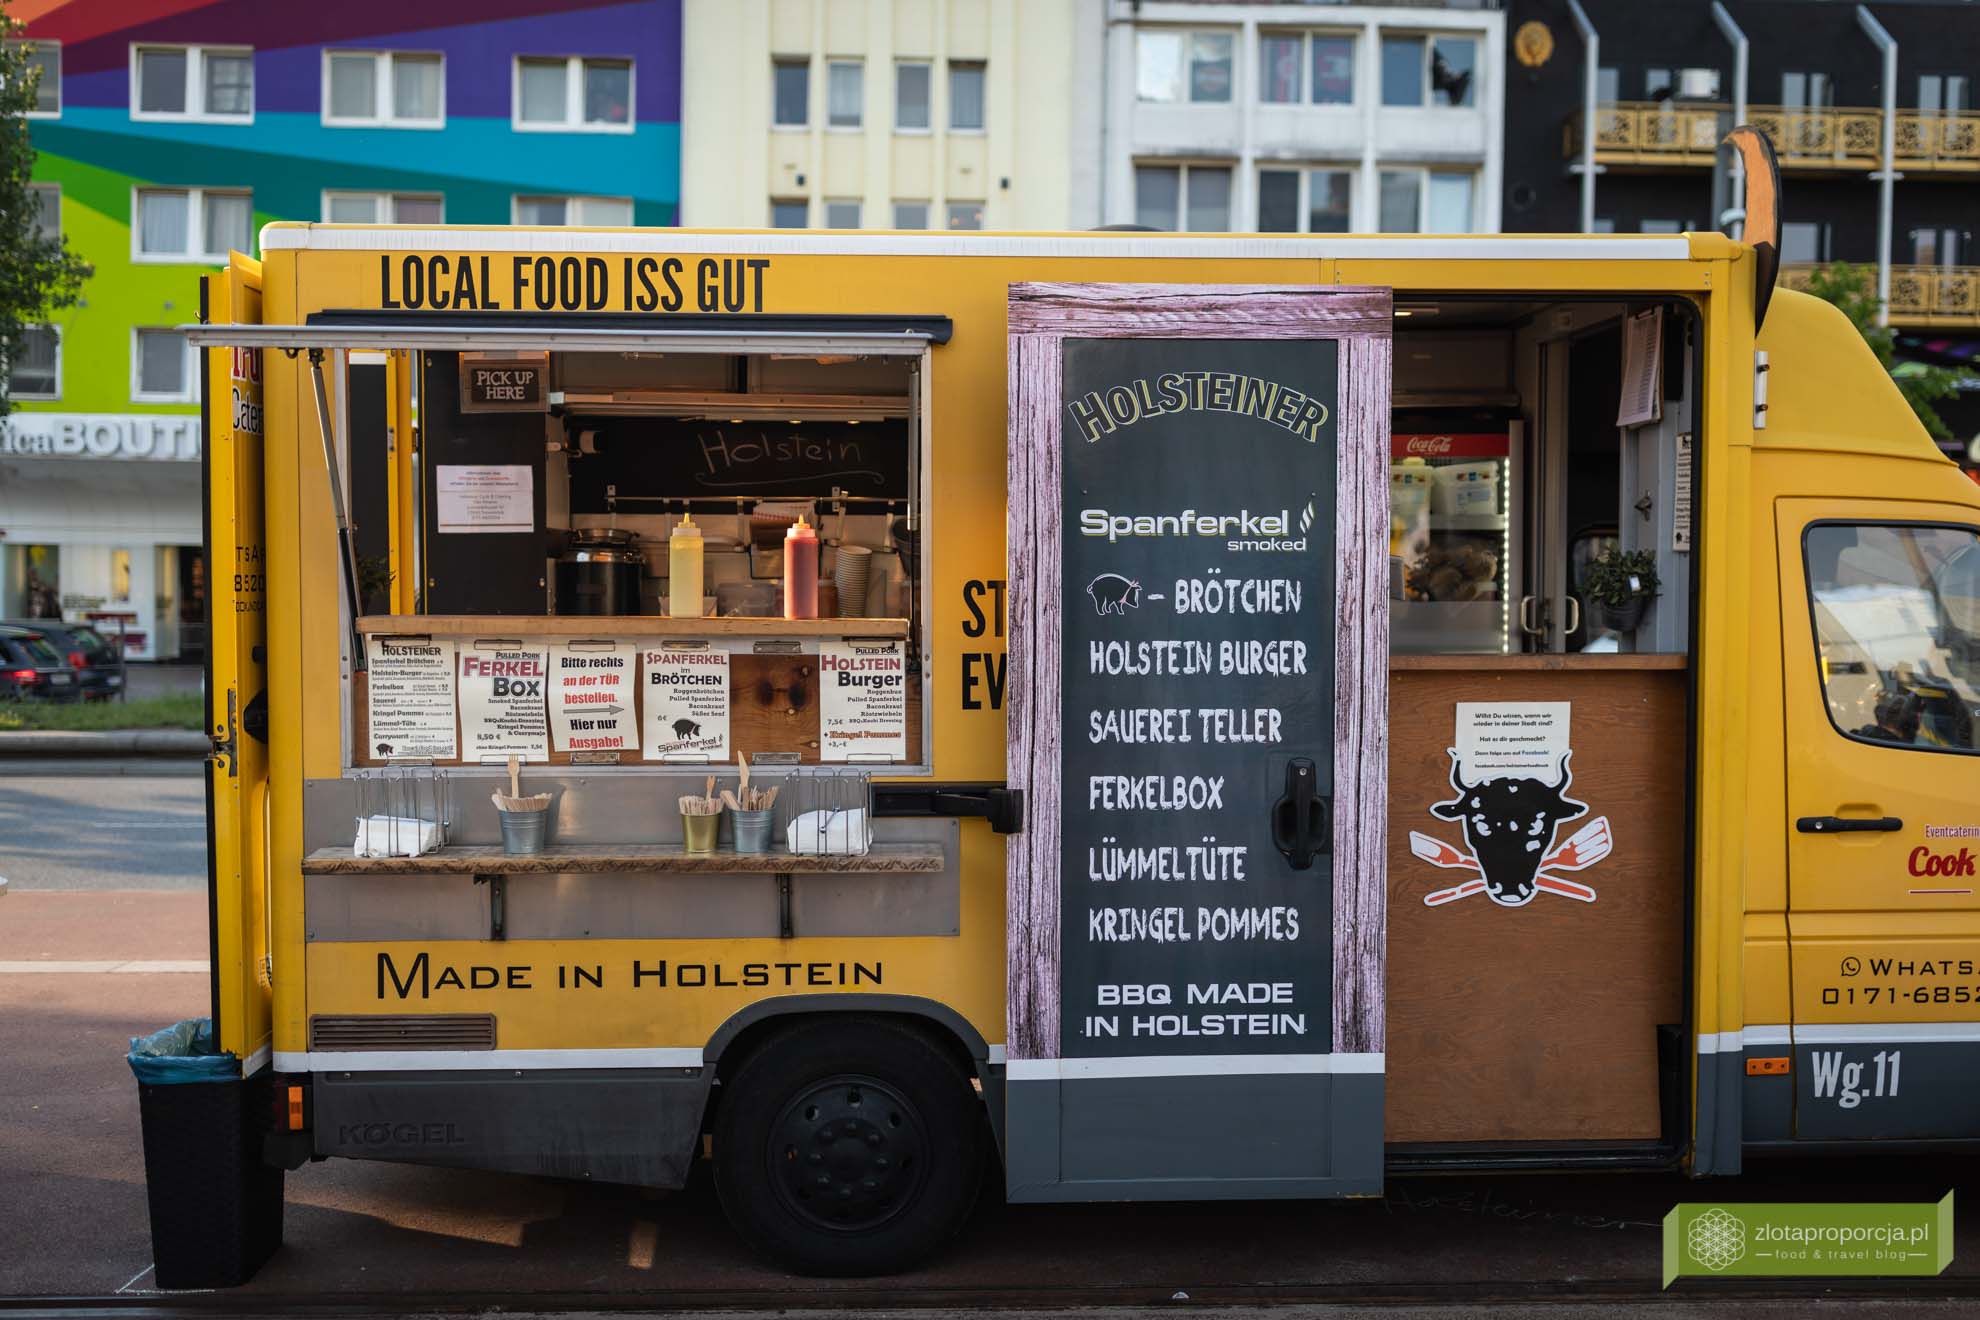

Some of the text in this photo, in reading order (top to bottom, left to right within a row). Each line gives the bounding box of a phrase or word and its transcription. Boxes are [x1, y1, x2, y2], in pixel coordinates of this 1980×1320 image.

[381, 254, 770, 313] LOCAL FOOD ISS GUT
[477, 371, 534, 386] PICK UP
[486, 386, 526, 400] HERE
[1068, 371, 1329, 443] HOLSTEINER
[698, 430, 862, 474] Holstein
[1407, 436, 1454, 453] Coca-Cola
[1080, 509, 1289, 543] Spanferkel
[1227, 538, 1307, 552] smoked
[1174, 567, 1302, 615] BRÖTCHEN
[382, 647, 442, 656] HOLSTEINER
[647, 652, 728, 664] SPANFERKEL
[1090, 640, 1308, 677] HOLSTEIN BURGER
[463, 657, 545, 677] FERKEL
[561, 657, 624, 668] Bitte rechts
[821, 655, 901, 671] HOLSTEIN
[563, 674, 620, 686] an der TÜR
[651, 672, 722, 685] BRÖTCHEN
[838, 671, 903, 688] Burger
[564, 692, 618, 704] bestellen.
[570, 718, 617, 730] Hier nur
[1089, 708, 1283, 743] SAUEREI TELLER
[569, 736, 624, 749] Ausgabe!
[657, 736, 717, 752] Spanferkel
[1089, 776, 1225, 811] FERKELBOX
[1089, 836, 1248, 882] LÜMMELTÜTE
[1907, 845, 1978, 877] Cook
[1089, 906, 1300, 944] KRINGEL POMMES
[376, 952, 532, 999] MADE
[633, 960, 883, 988] HOLSTEIN
[1869, 958, 1980, 976] WHATS
[1097, 982, 1294, 1006] BBQ MADE
[1085, 1013, 1305, 1037] IN HOLSTEIN
[1811, 1050, 1901, 1109] Wg.11
[338, 1122, 465, 1146] KÖGEL
